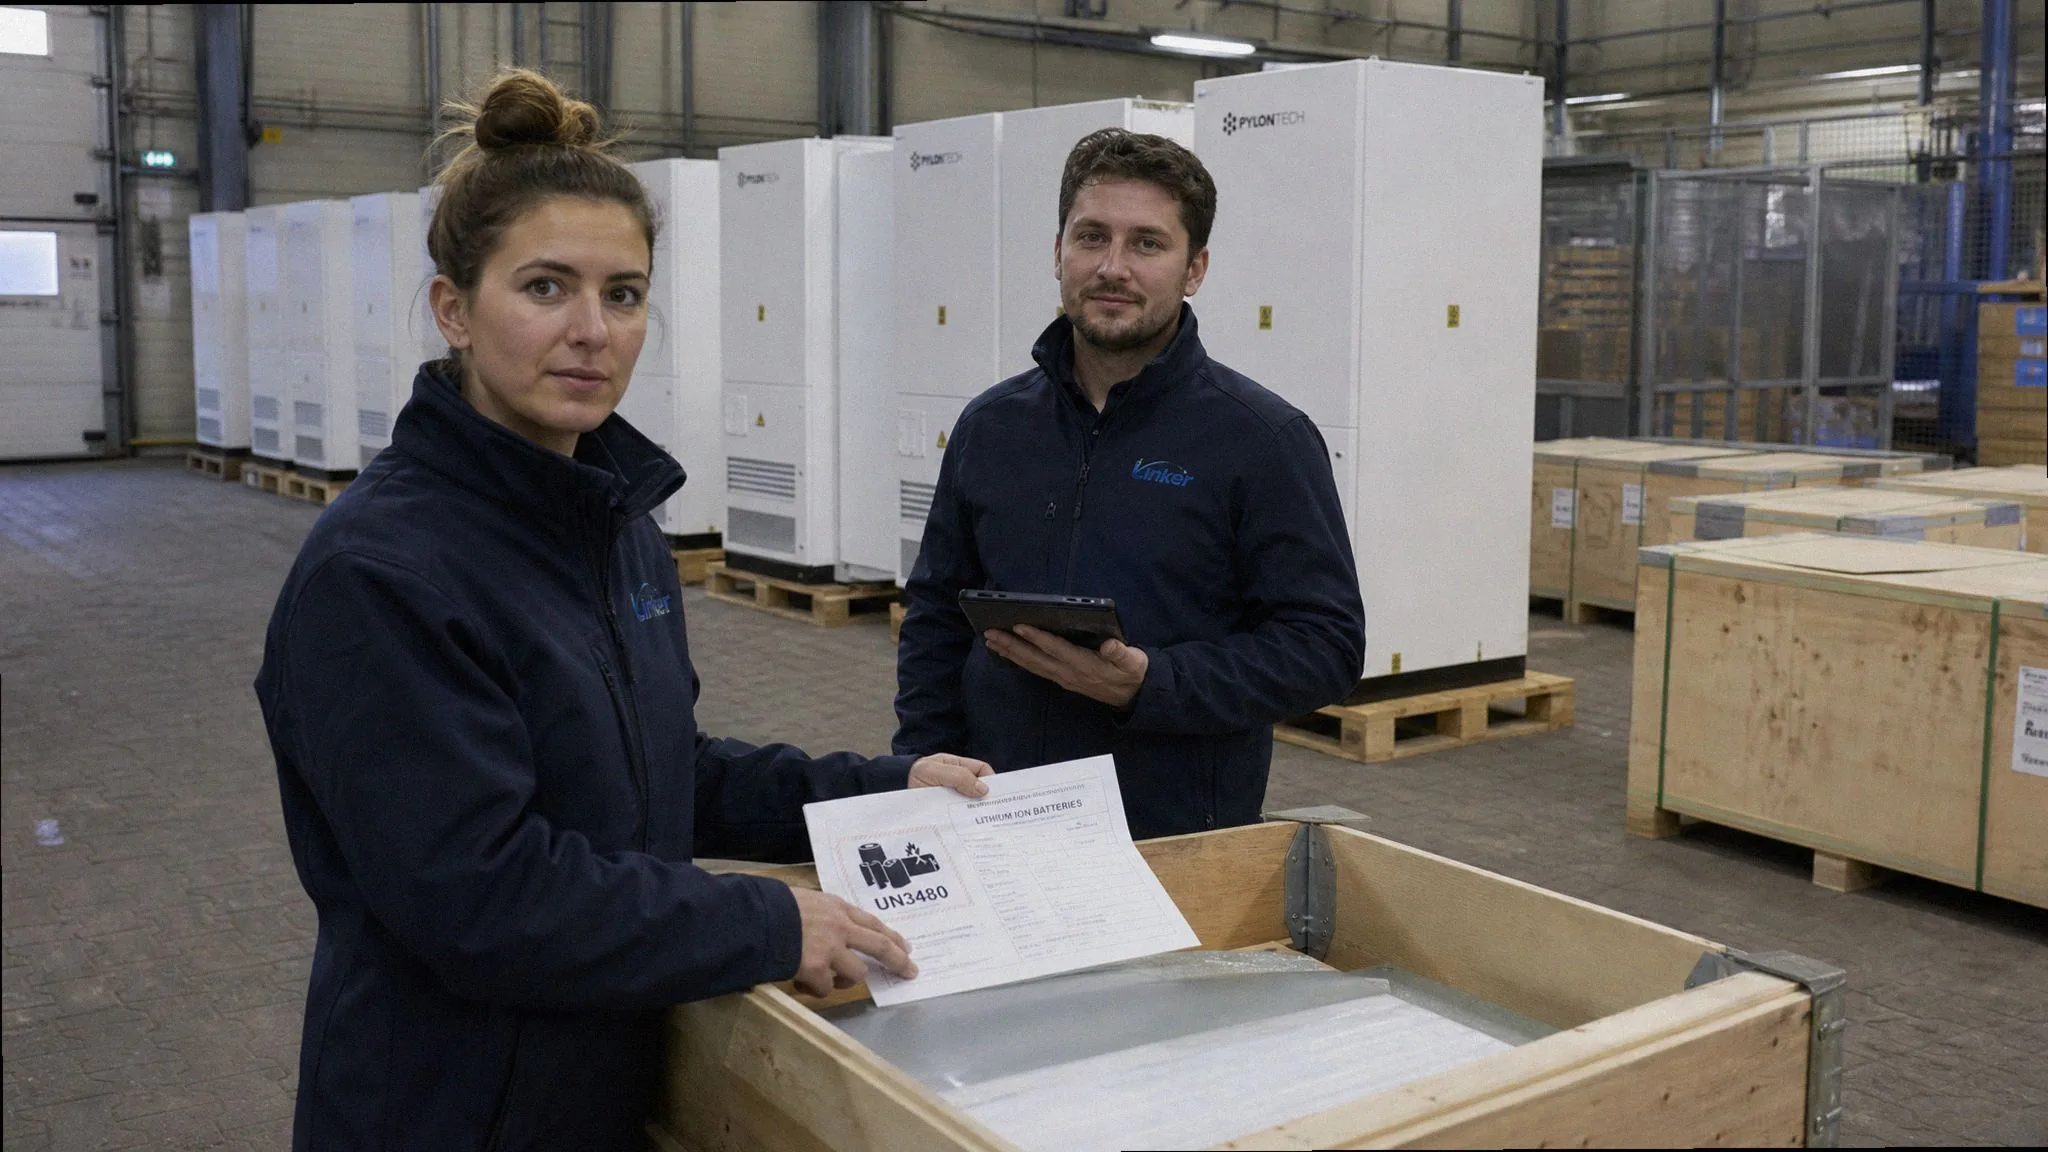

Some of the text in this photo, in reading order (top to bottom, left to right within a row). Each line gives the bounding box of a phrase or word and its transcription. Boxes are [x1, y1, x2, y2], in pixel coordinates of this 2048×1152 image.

[1239, 110, 1305, 129] PYLONTECH
[975, 812, 1013, 825] LITHIUM
[1014, 809, 1032, 819] ION
[1033, 799, 1084, 816] BATTERIES
[874, 885, 949, 911] UN3480
